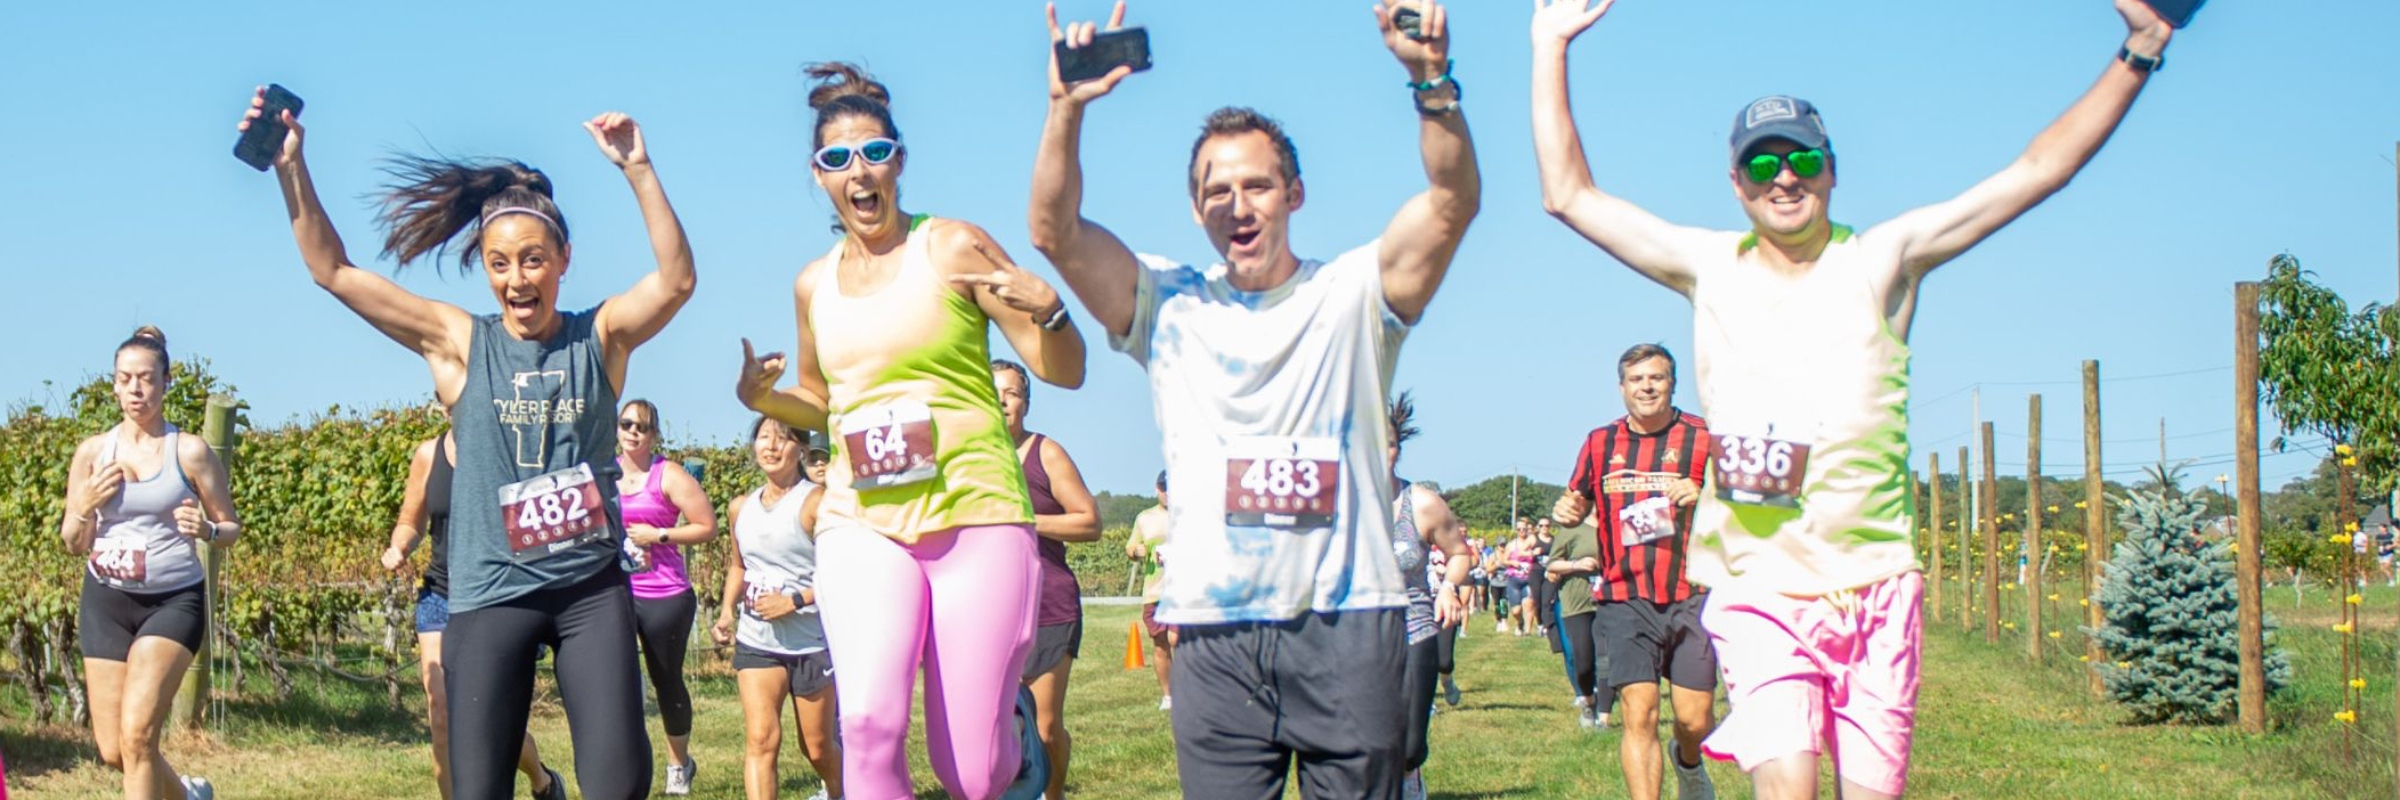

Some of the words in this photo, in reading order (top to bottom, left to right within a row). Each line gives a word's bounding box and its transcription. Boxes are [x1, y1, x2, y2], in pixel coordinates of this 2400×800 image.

[500, 413, 538, 425] FAMILY
[539, 412, 577, 424] RSORT
[541, 398, 584, 414] PACE
[865, 421, 908, 461] 64
[1718, 435, 1793, 478] 336
[1241, 458, 1320, 498] 483
[518, 487, 588, 531] 482
